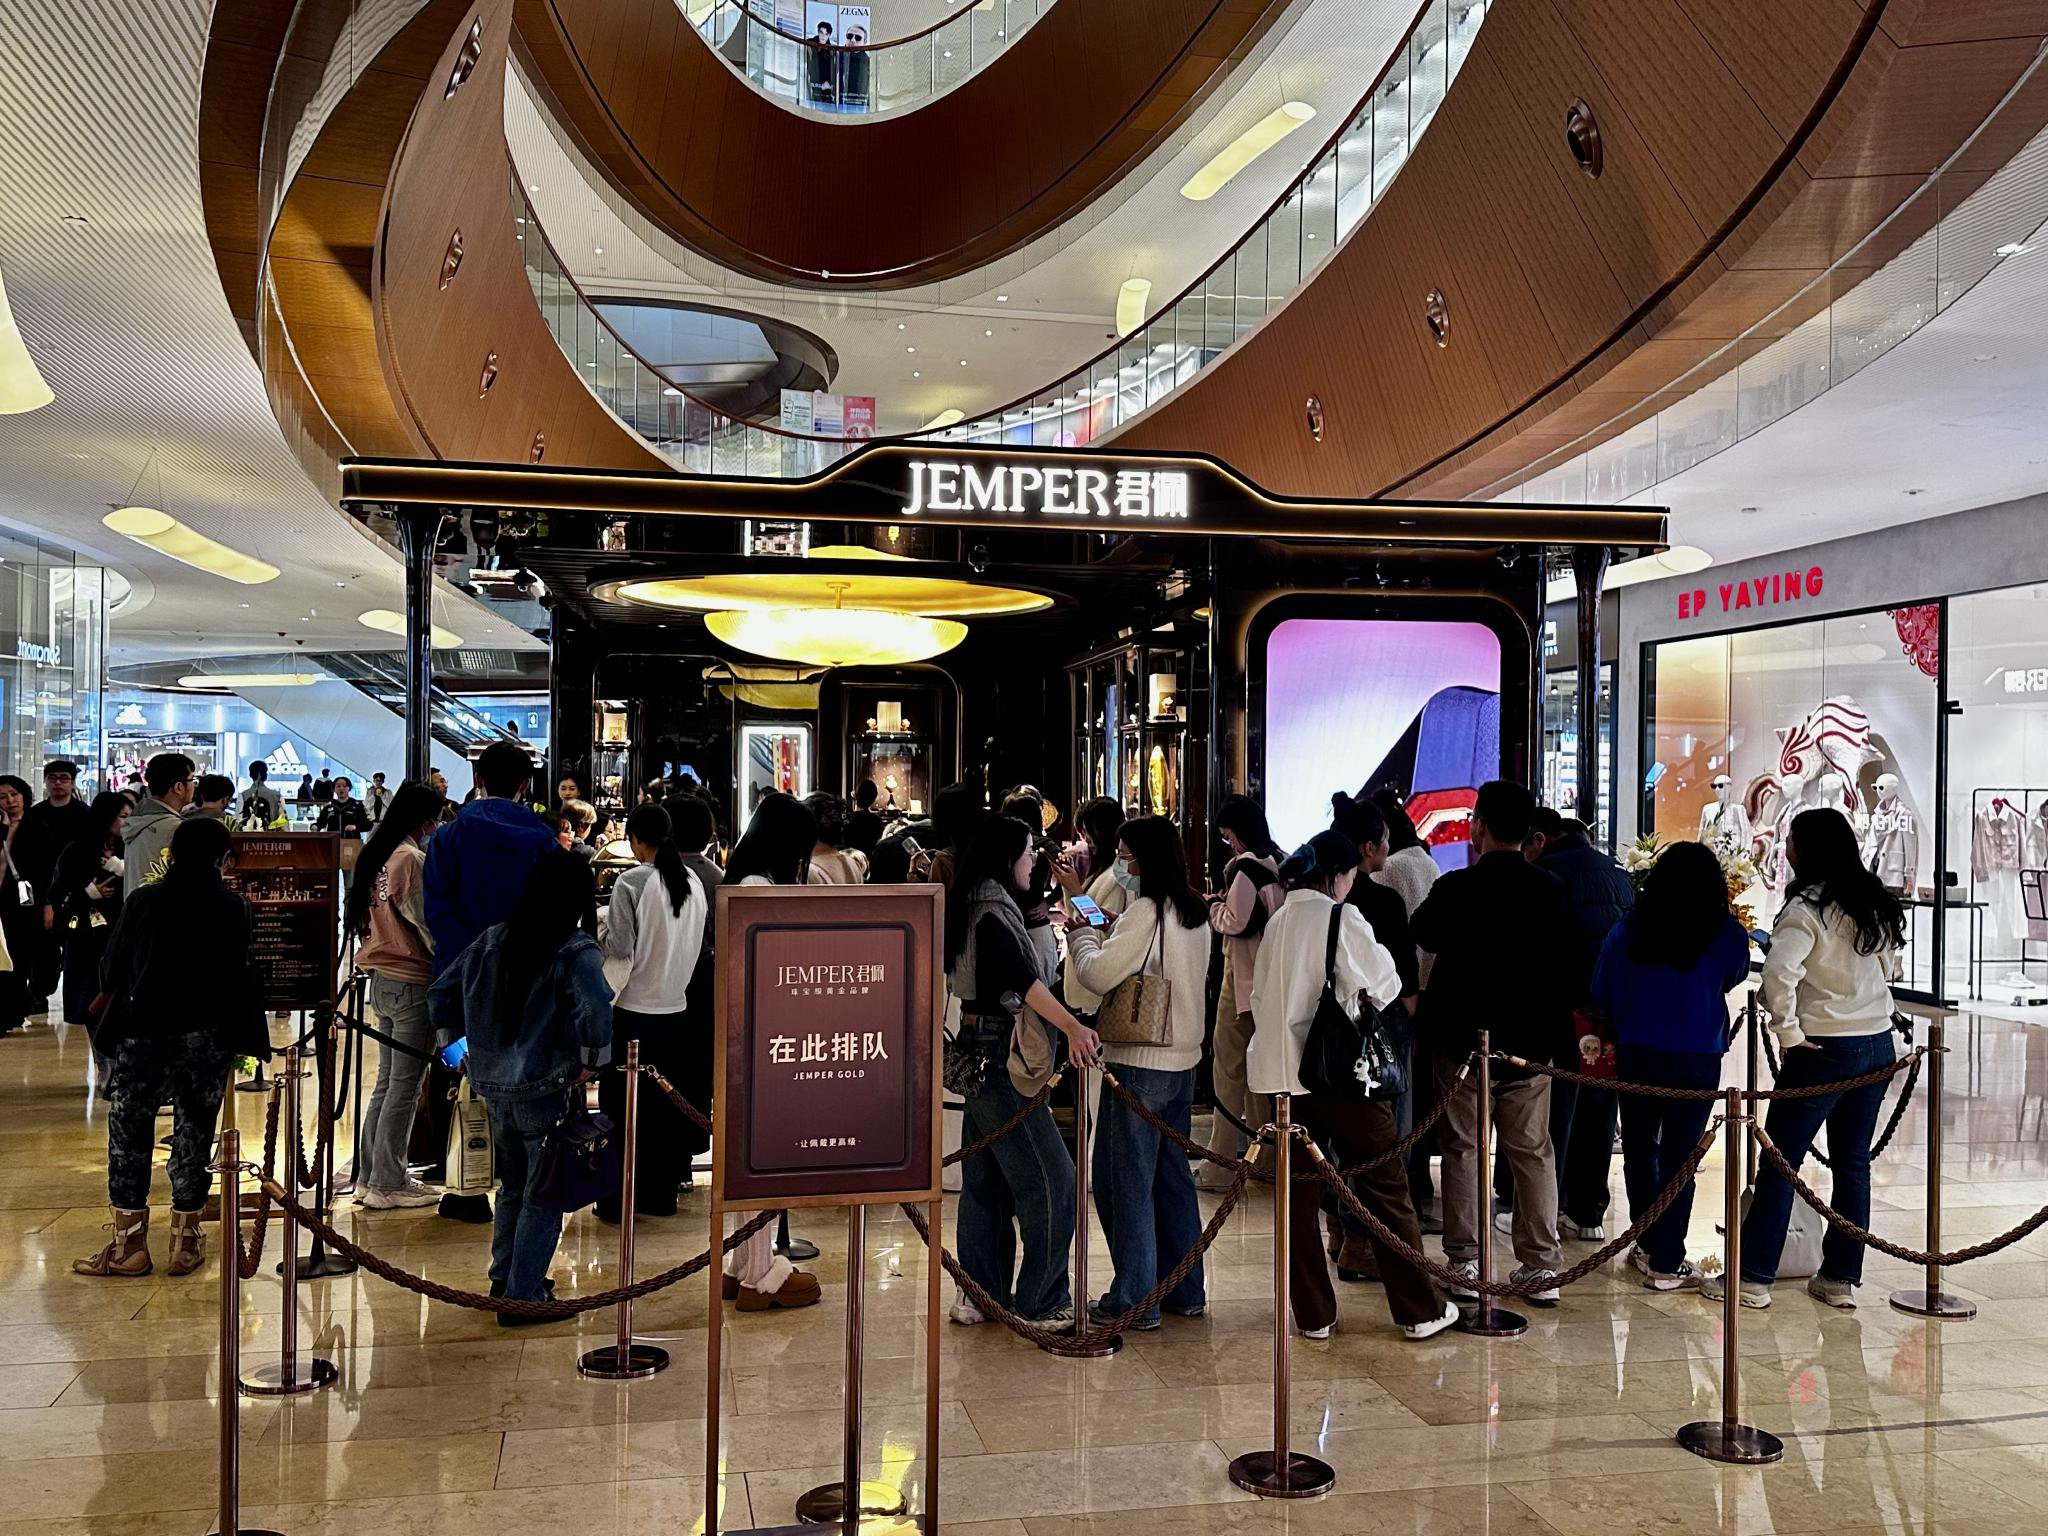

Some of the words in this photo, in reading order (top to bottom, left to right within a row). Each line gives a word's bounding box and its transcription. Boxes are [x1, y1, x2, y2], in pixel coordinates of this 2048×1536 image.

[841, 7, 869, 17] ZEGNA
[1678, 590, 1706, 619] EP
[1719, 566, 1824, 611] YAYING
[769, 1031, 889, 1063] 在此排队
[793, 1071, 834, 1080] JEMPER
[837, 1070, 865, 1079] GOLD
